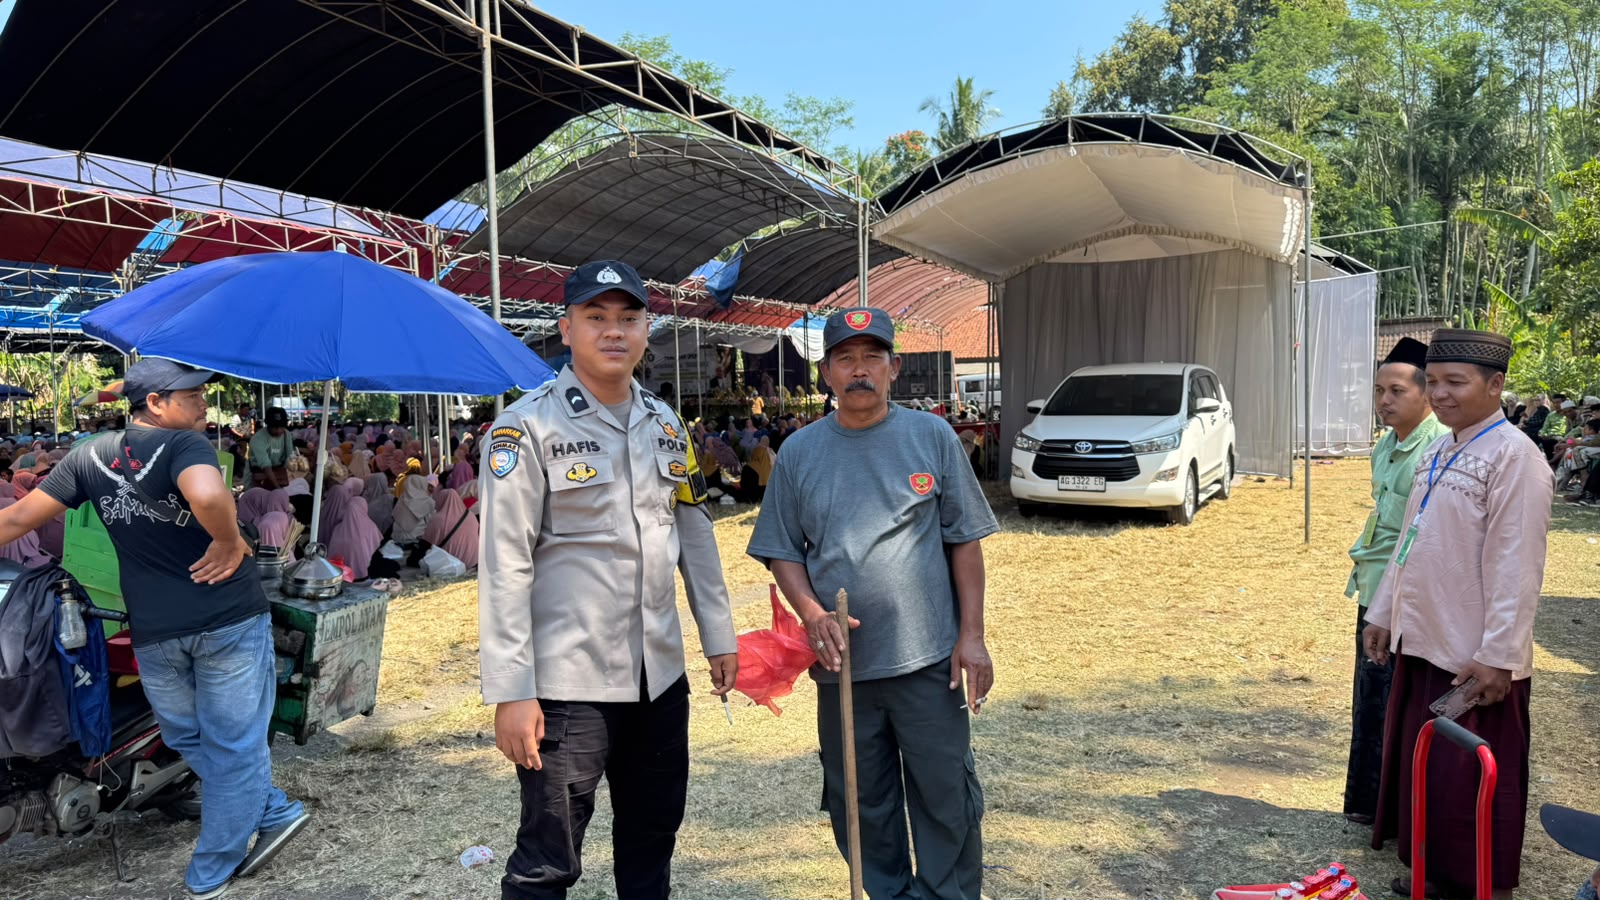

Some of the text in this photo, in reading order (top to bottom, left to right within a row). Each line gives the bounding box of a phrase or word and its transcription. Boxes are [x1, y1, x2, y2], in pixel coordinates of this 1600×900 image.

[492, 442, 517, 450] BINMAS
[551, 440, 601, 457] HAFIS
[1060, 476, 1104, 486] AG 1322 EG
